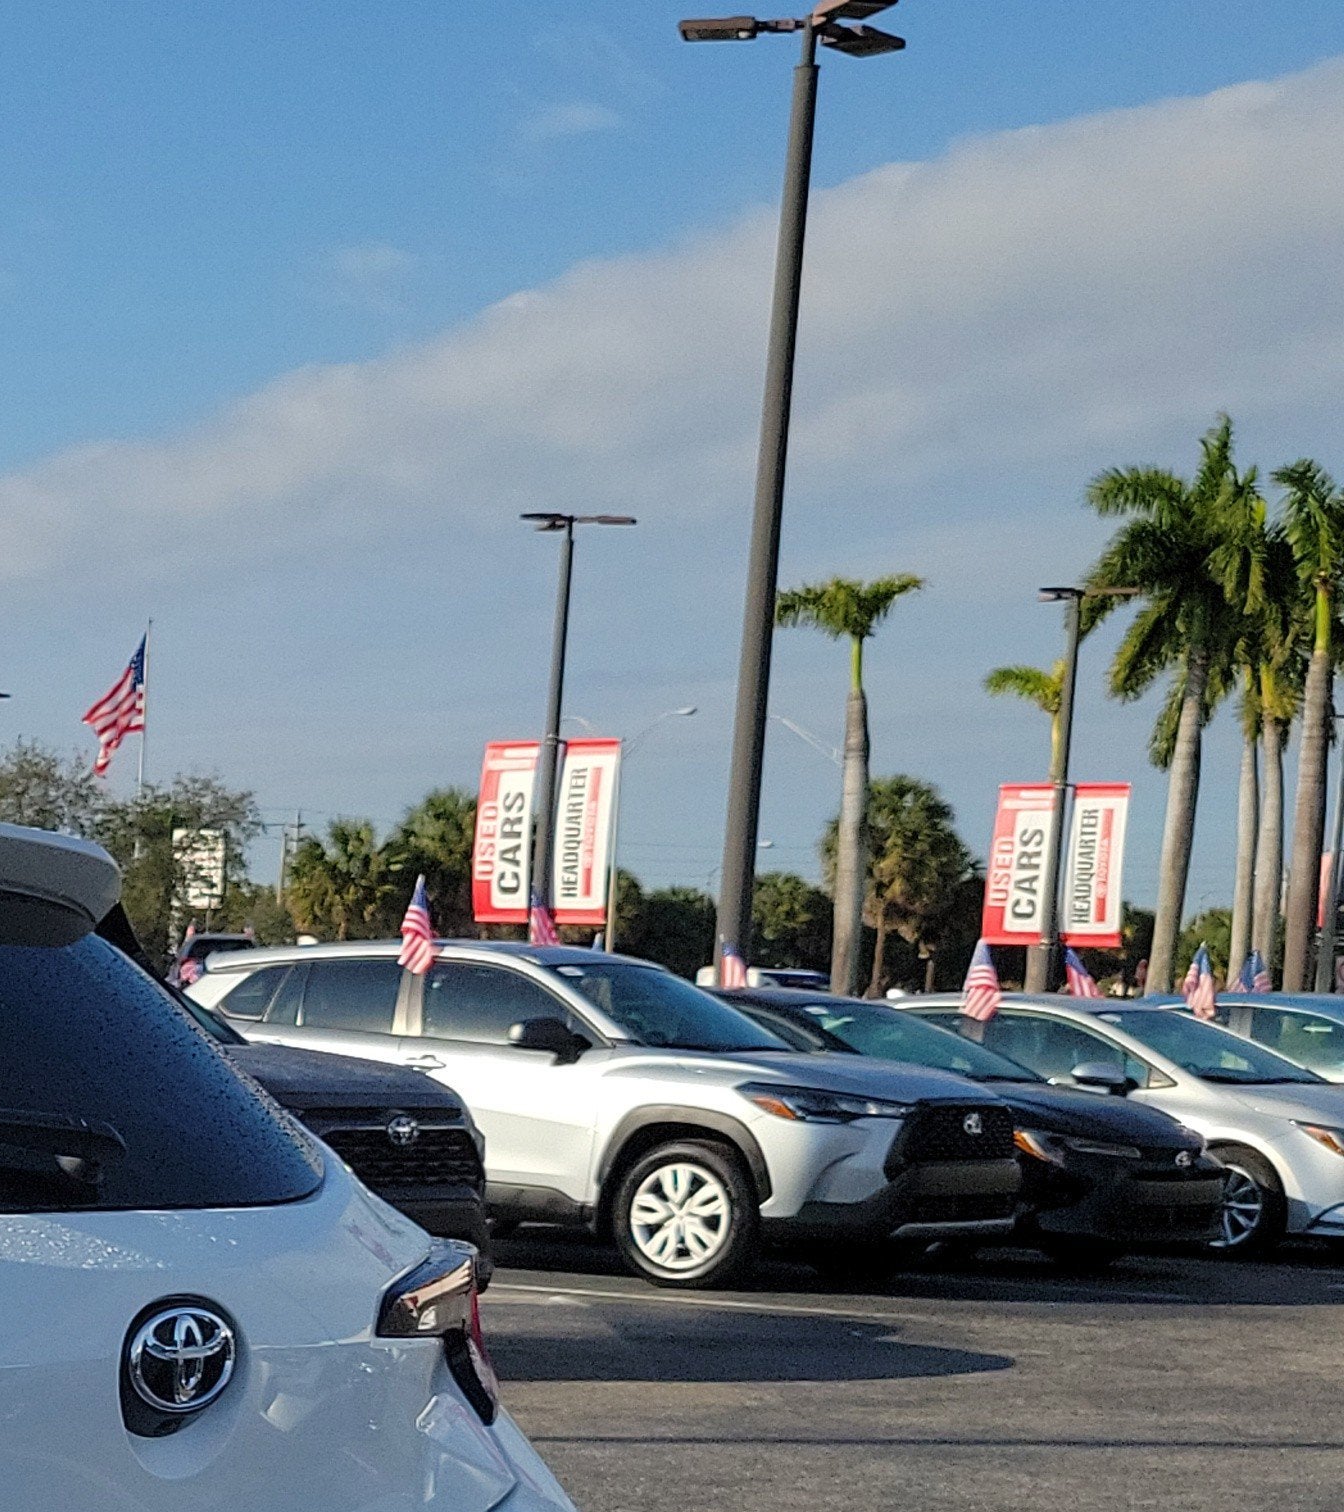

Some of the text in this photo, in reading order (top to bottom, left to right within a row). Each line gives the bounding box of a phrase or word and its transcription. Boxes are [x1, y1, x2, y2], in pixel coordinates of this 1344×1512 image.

[476, 804, 498, 881] USED
[498, 791, 526, 895] CARS
[561, 767, 588, 898] HEADQUARTER
[990, 836, 1014, 907] USED
[1012, 828, 1045, 920] CARS
[1072, 809, 1099, 924] HEADQUARTER
